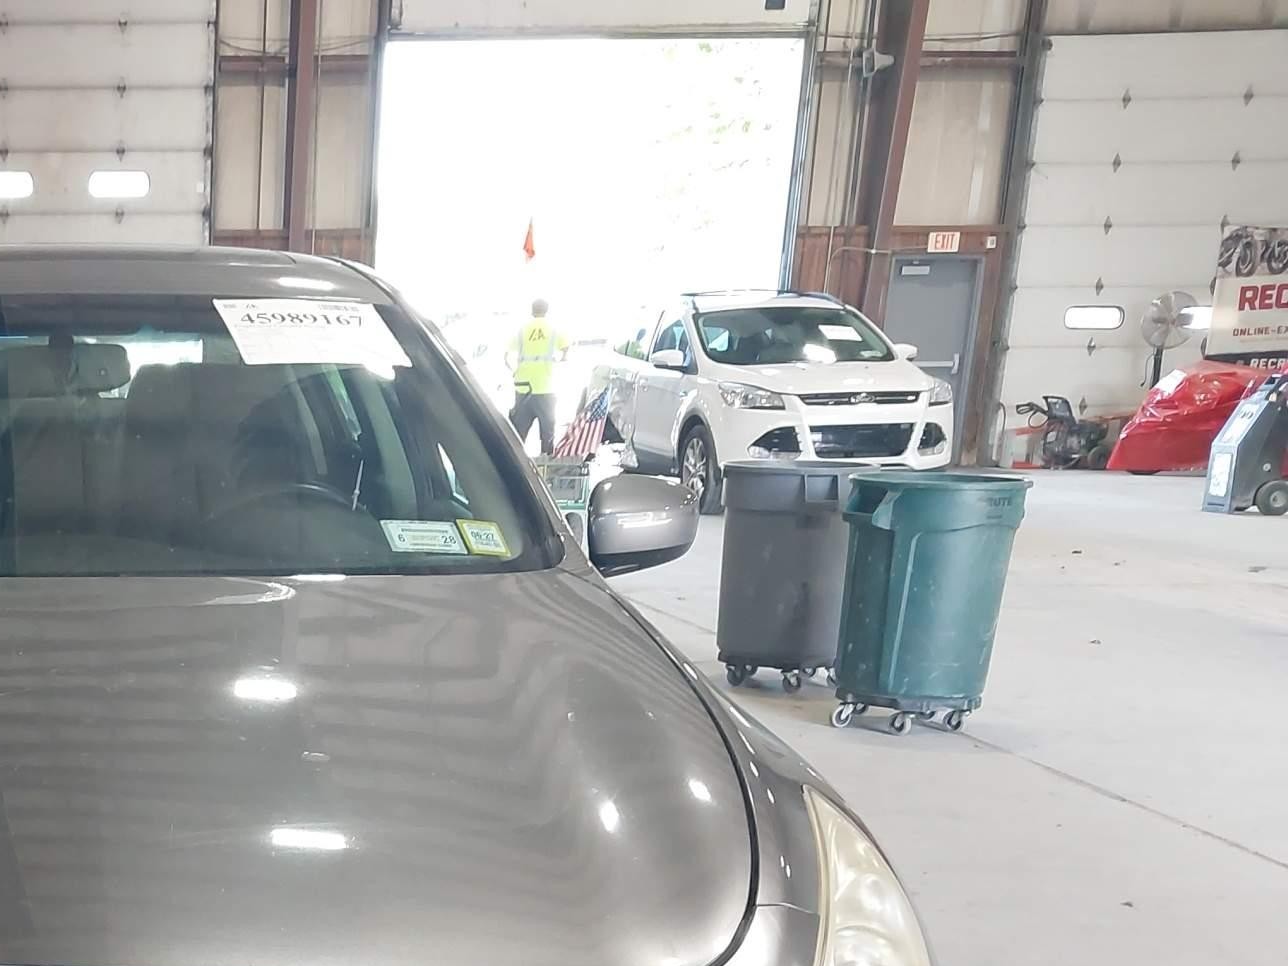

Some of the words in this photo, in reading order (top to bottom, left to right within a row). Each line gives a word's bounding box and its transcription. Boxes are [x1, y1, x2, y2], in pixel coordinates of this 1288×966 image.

[934, 233, 956, 250] EXIT
[240, 311, 363, 328] 45989167
[397, 533, 406, 543] 6
[441, 535, 457, 545] 28
